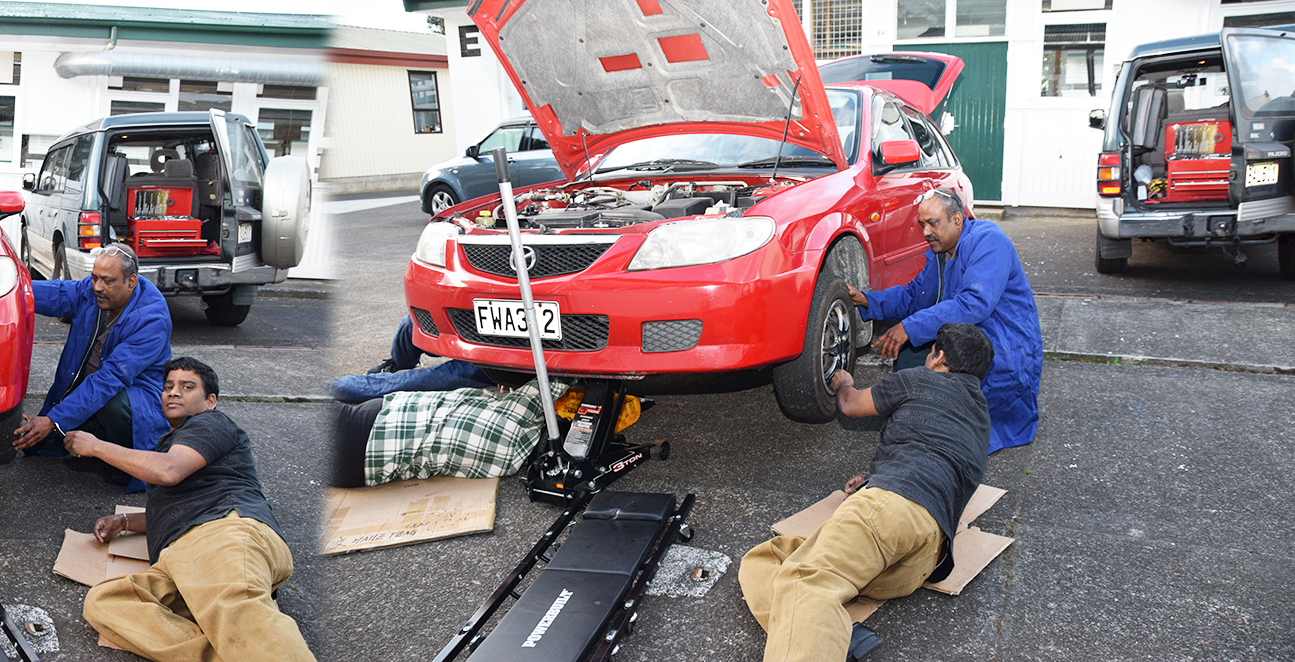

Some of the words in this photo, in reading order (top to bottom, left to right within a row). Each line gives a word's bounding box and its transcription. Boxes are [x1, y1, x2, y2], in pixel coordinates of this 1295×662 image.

[458, 25, 481, 57] E
[478, 306, 555, 334] FWA32
[521, 588, 574, 648] POWERBUILT
